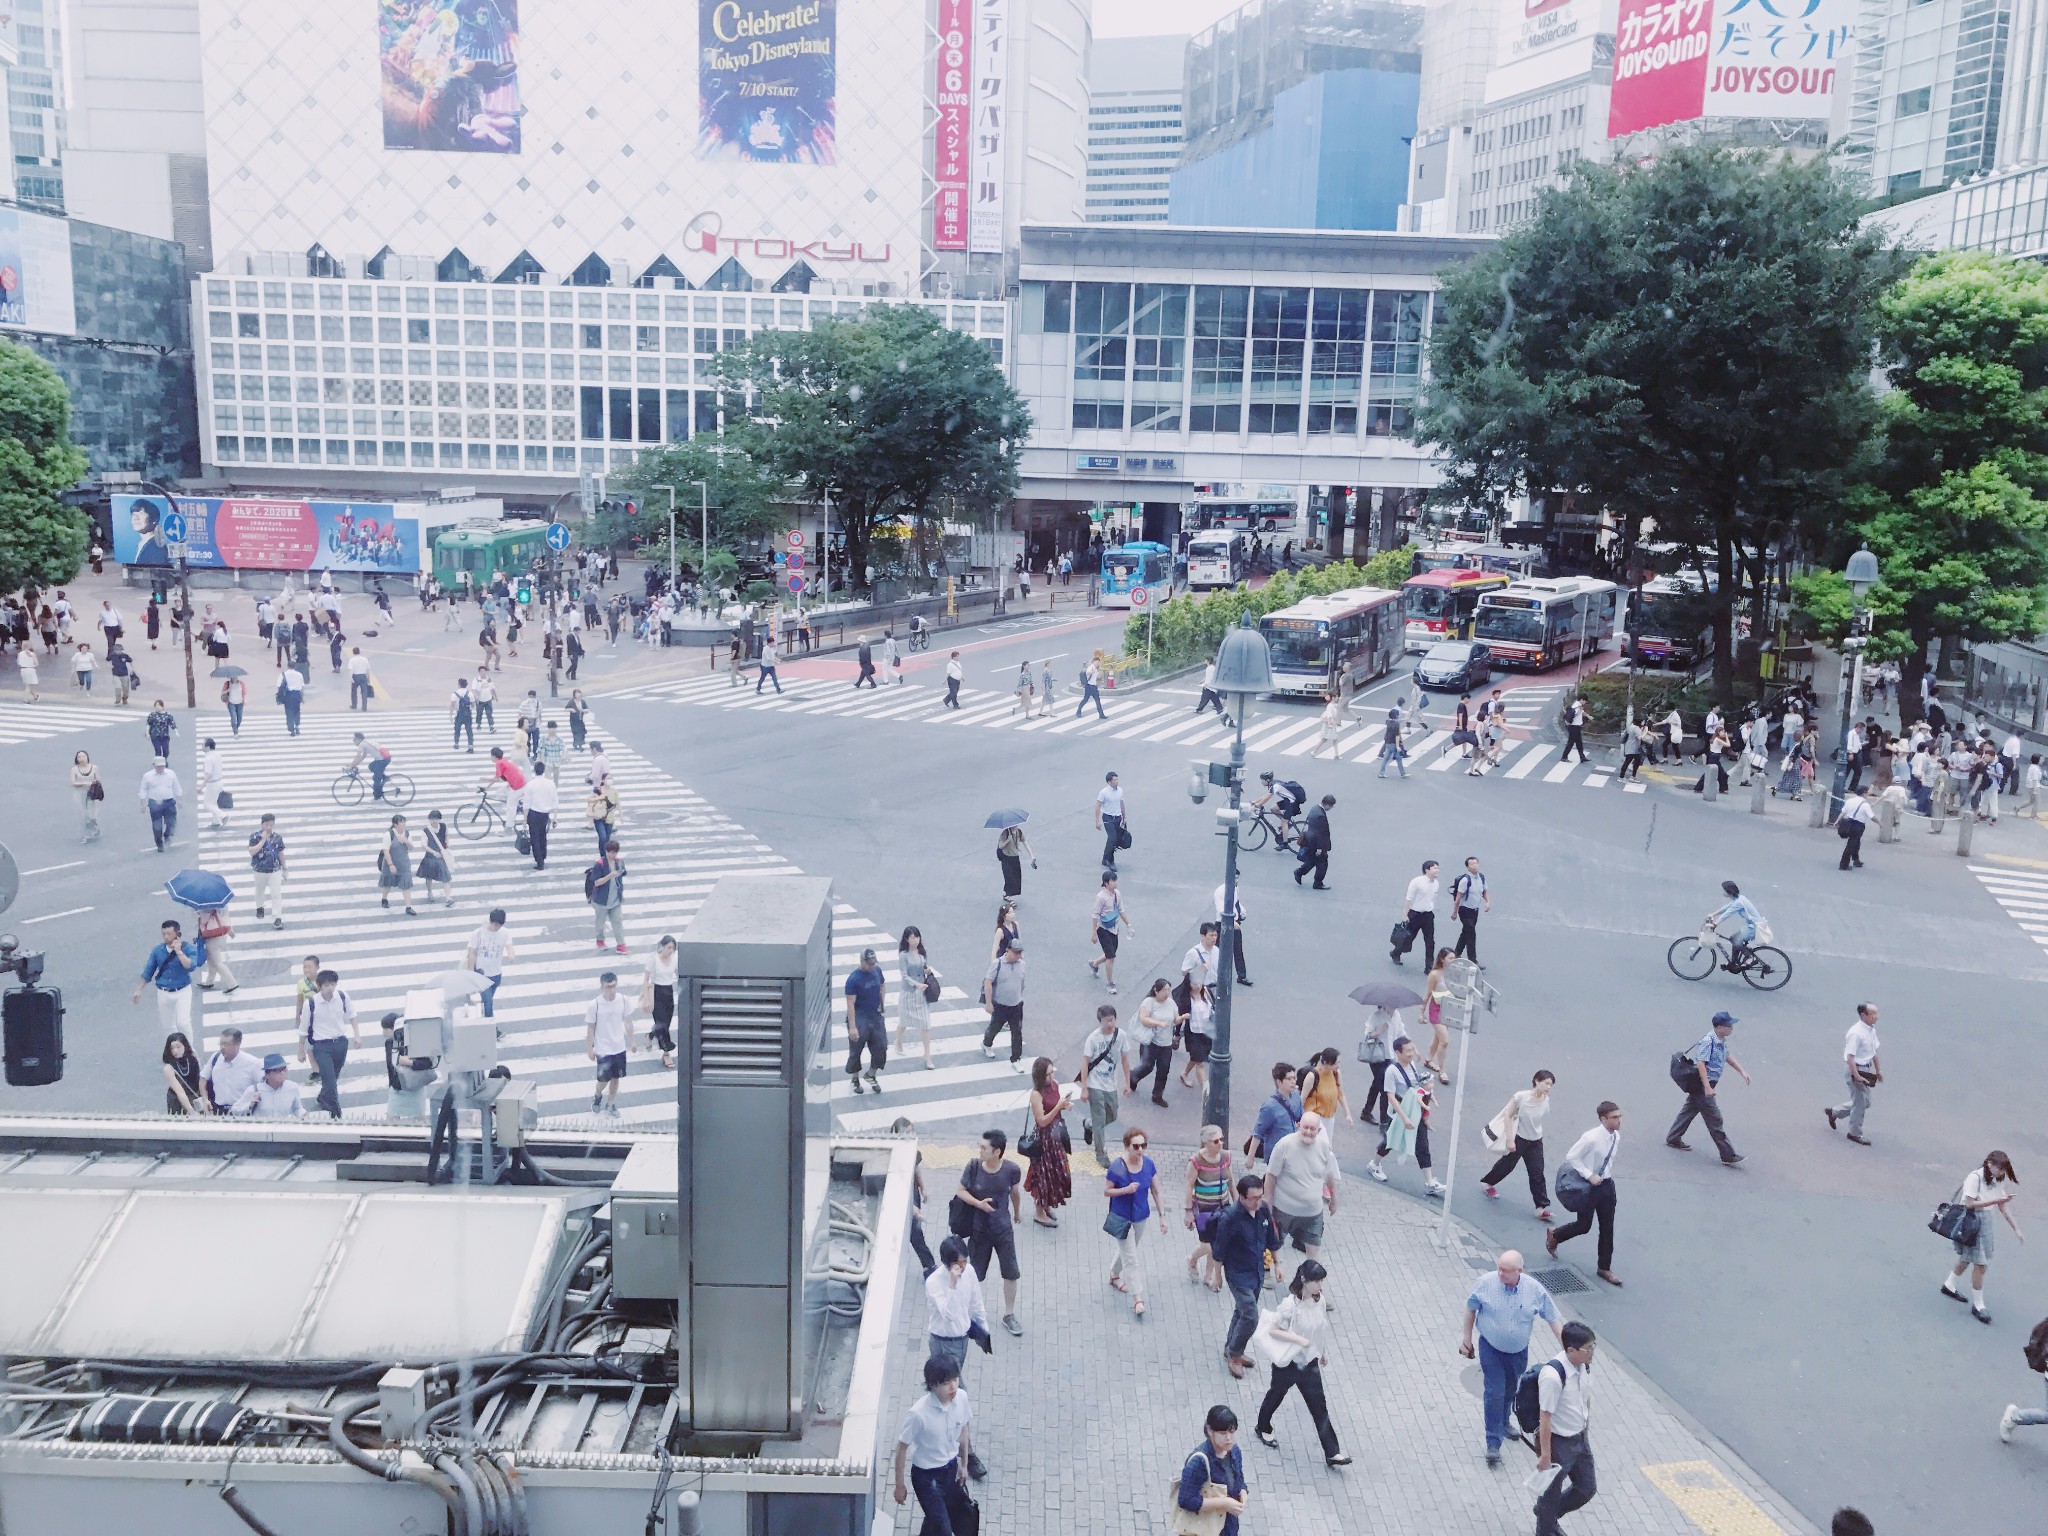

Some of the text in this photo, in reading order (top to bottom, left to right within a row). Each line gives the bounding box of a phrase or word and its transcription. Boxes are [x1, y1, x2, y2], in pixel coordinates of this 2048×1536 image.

[713, 1, 820, 43] Celebrate!
[1528, 19, 1578, 48] MasterCard
[1538, 11, 1558, 29] VISA
[1620, 0, 1702, 51] カラオケ
[704, 36, 831, 72] Tokyo Disneyland
[1616, 30, 1708, 81] JOYSOUND
[739, 82, 799, 97] 7/10 START!
[945, 69, 962, 92] 6
[939, 92, 968, 106] DAYS
[946, 108, 960, 176] スペシャル
[944, 191, 959, 239] 開催中
[718, 237, 891, 263] TOKYU
